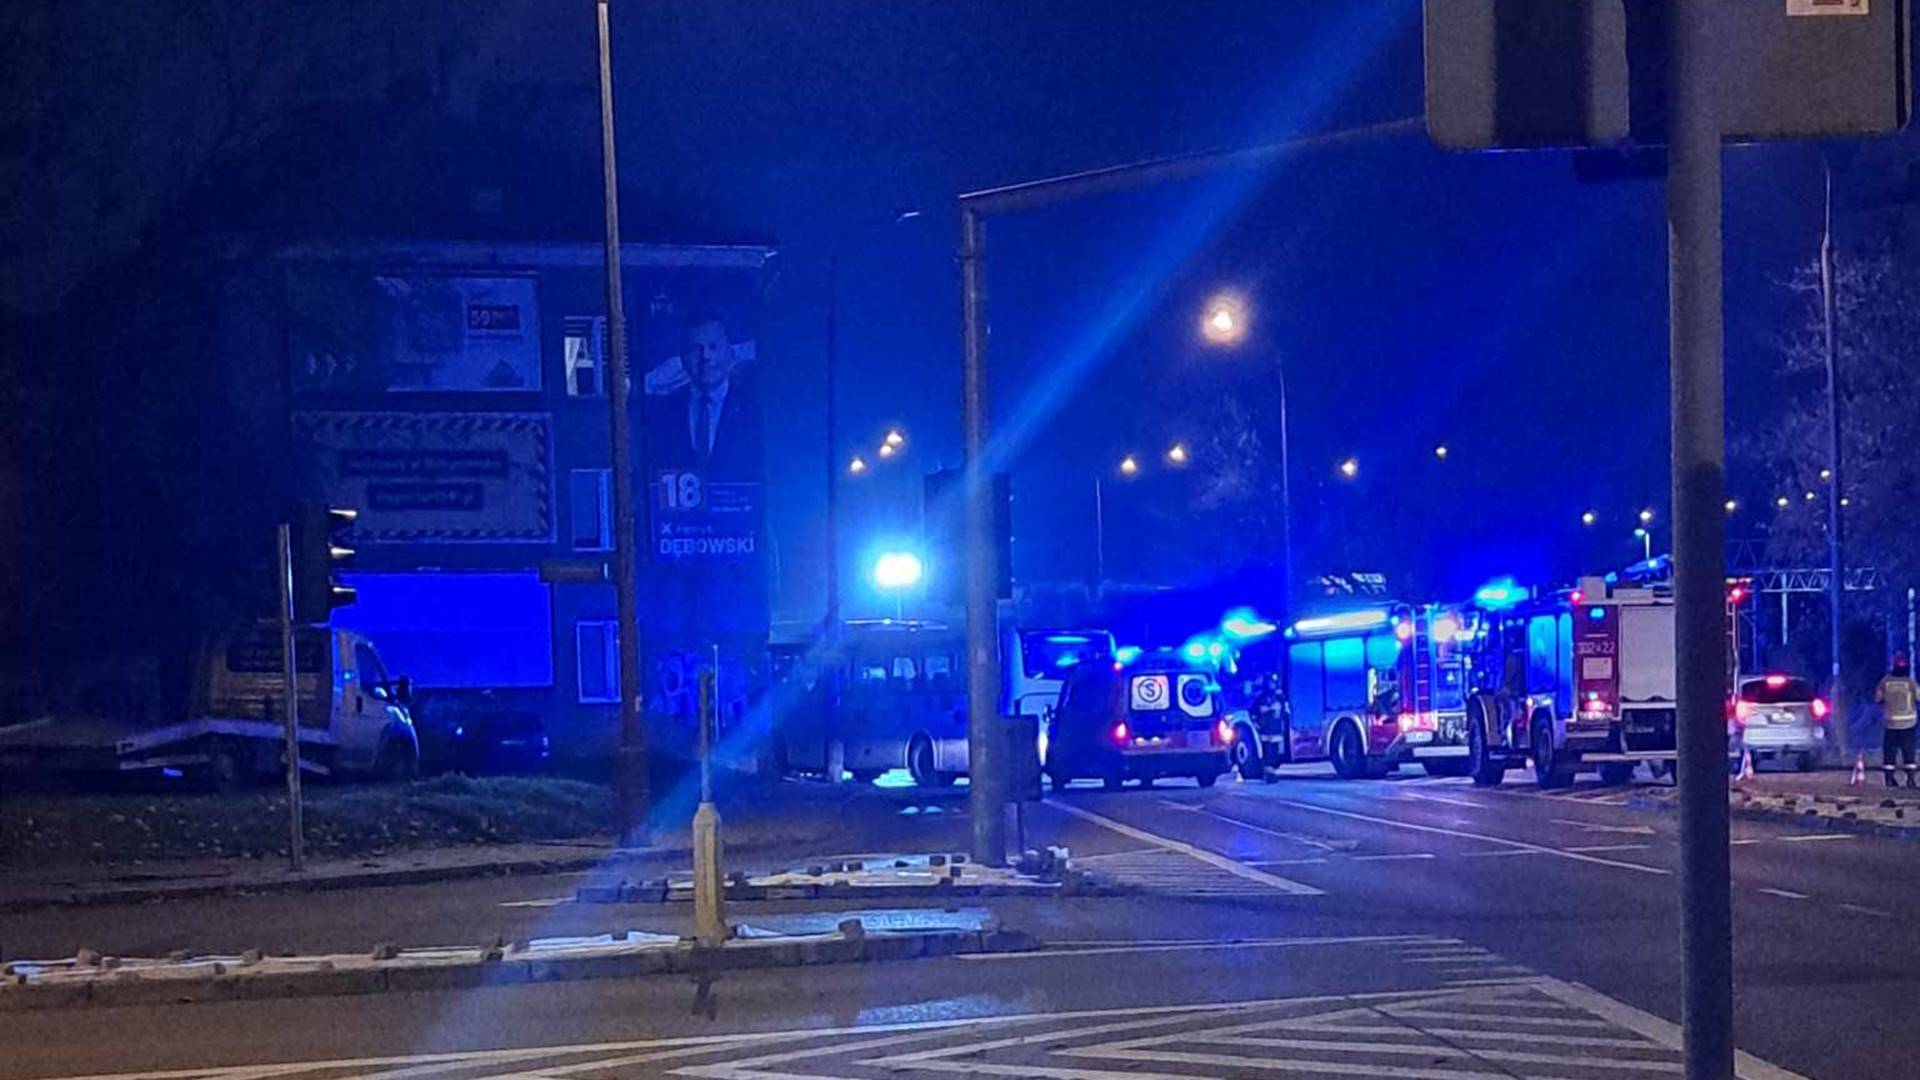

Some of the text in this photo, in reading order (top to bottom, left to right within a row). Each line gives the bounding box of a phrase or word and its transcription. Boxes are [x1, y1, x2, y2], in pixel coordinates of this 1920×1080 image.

[662, 472, 702, 508] 18
[660, 536, 755, 558] DĘBOWSKI
[1144, 682, 1156, 698] S
